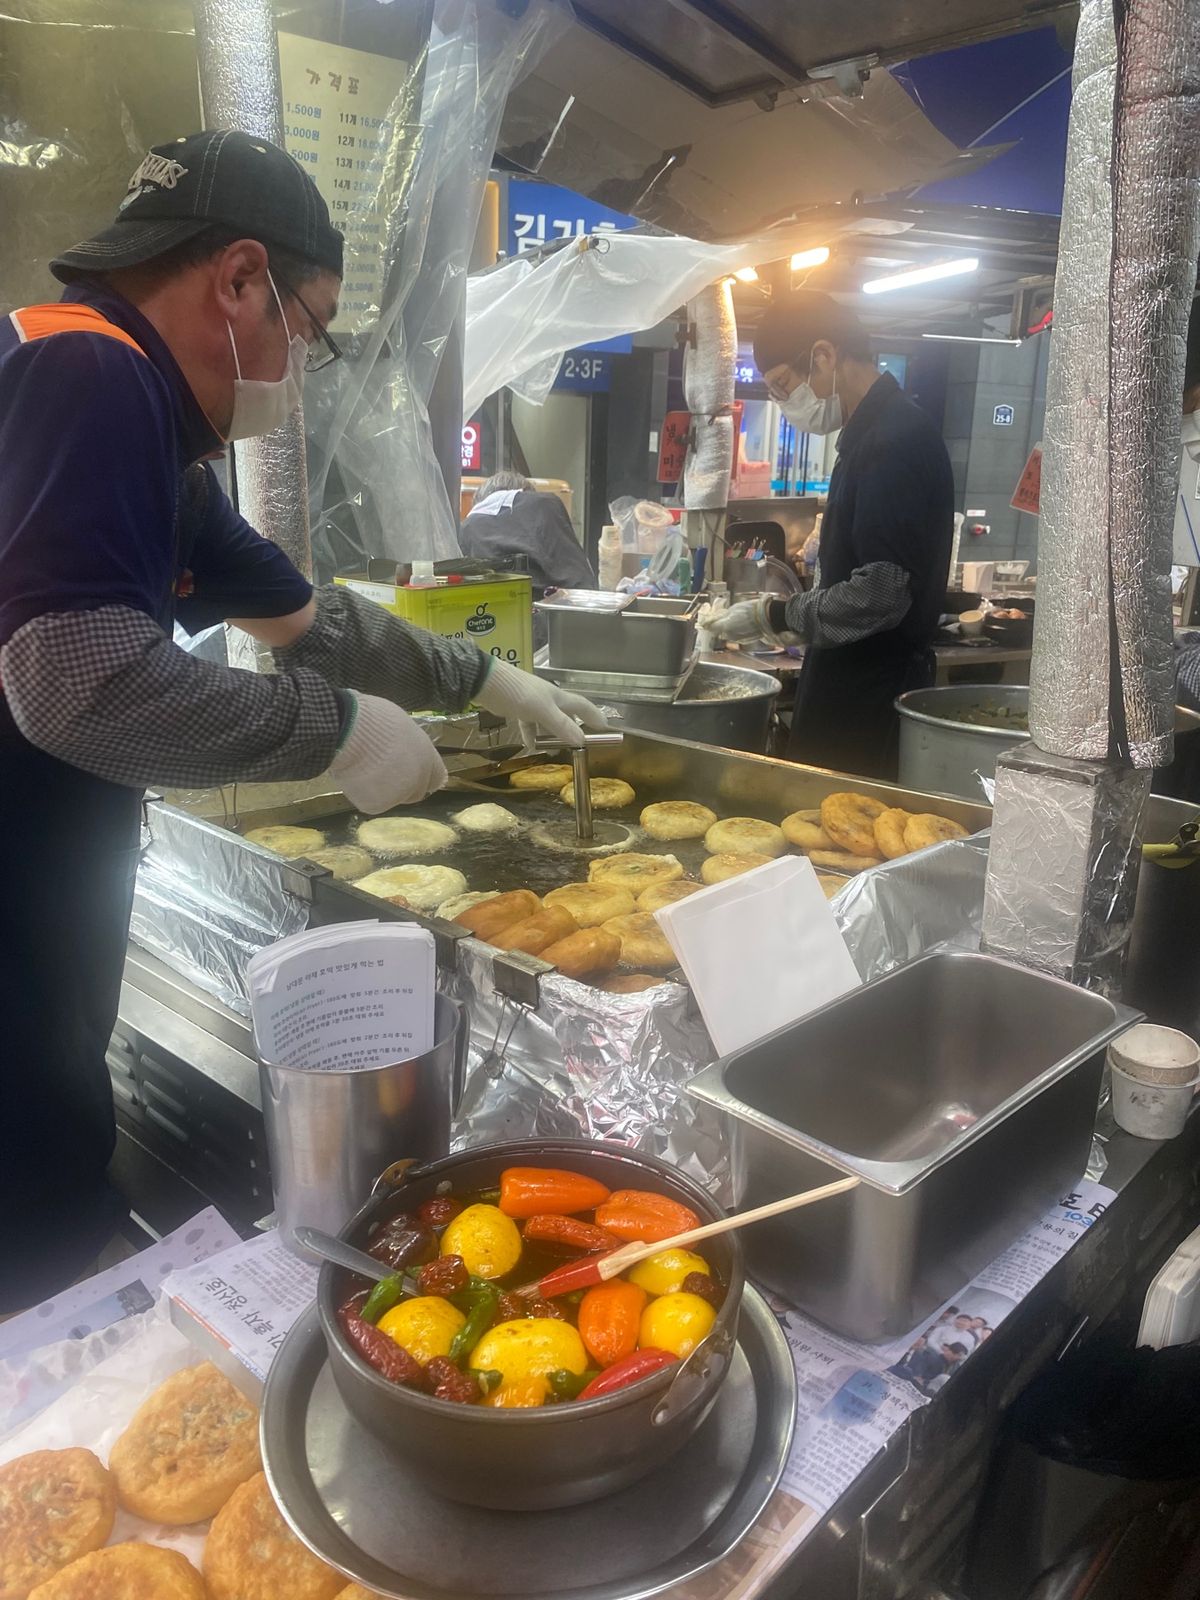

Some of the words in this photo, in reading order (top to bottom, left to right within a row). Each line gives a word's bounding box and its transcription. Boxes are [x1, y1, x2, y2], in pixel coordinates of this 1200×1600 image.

[340, 112, 357, 125] 11개
[338, 135, 355, 148] 12개
[336, 157, 353, 168] 13개
[334, 178, 351, 190] 14개
[332, 200, 348, 210] 15개
[241, 1310, 274, 1336] 흑자
